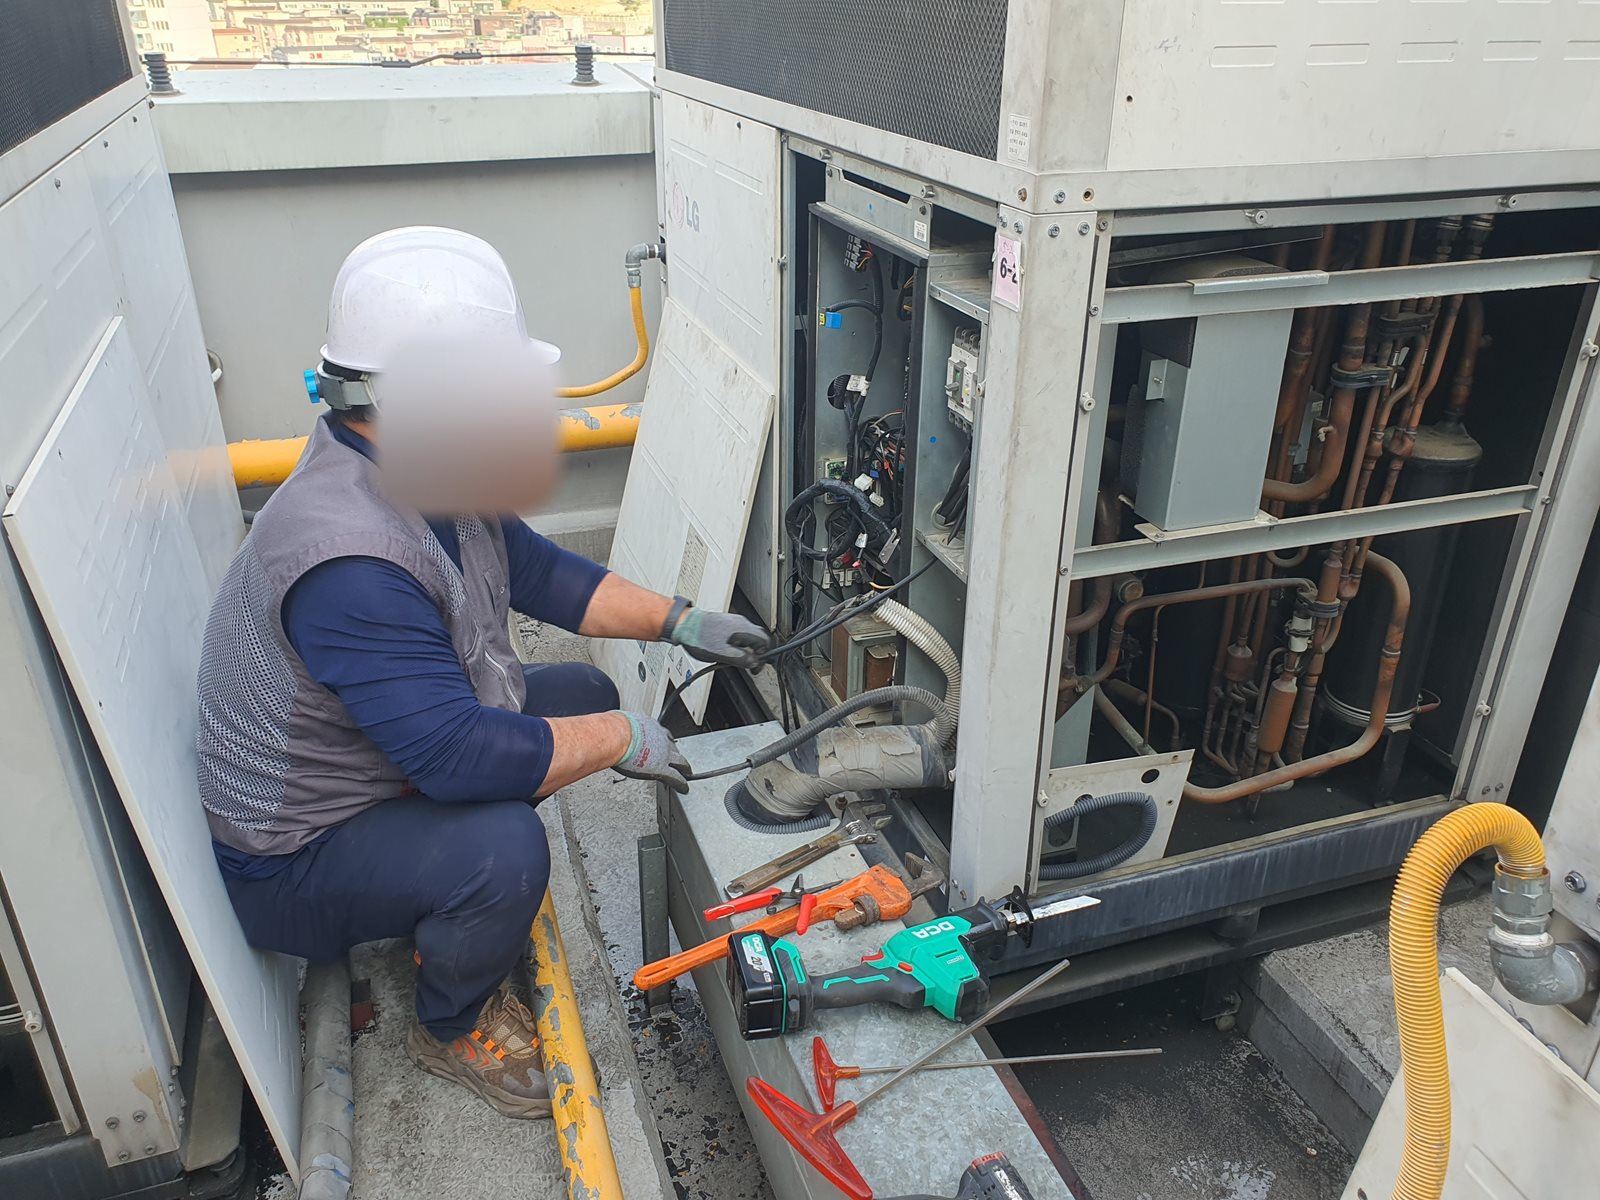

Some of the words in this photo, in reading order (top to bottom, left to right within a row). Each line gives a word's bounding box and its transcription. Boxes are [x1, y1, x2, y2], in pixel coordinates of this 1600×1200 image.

[685, 195, 700, 232] LG
[637, 747, 650, 768] 3M
[911, 921, 955, 938] DCA
